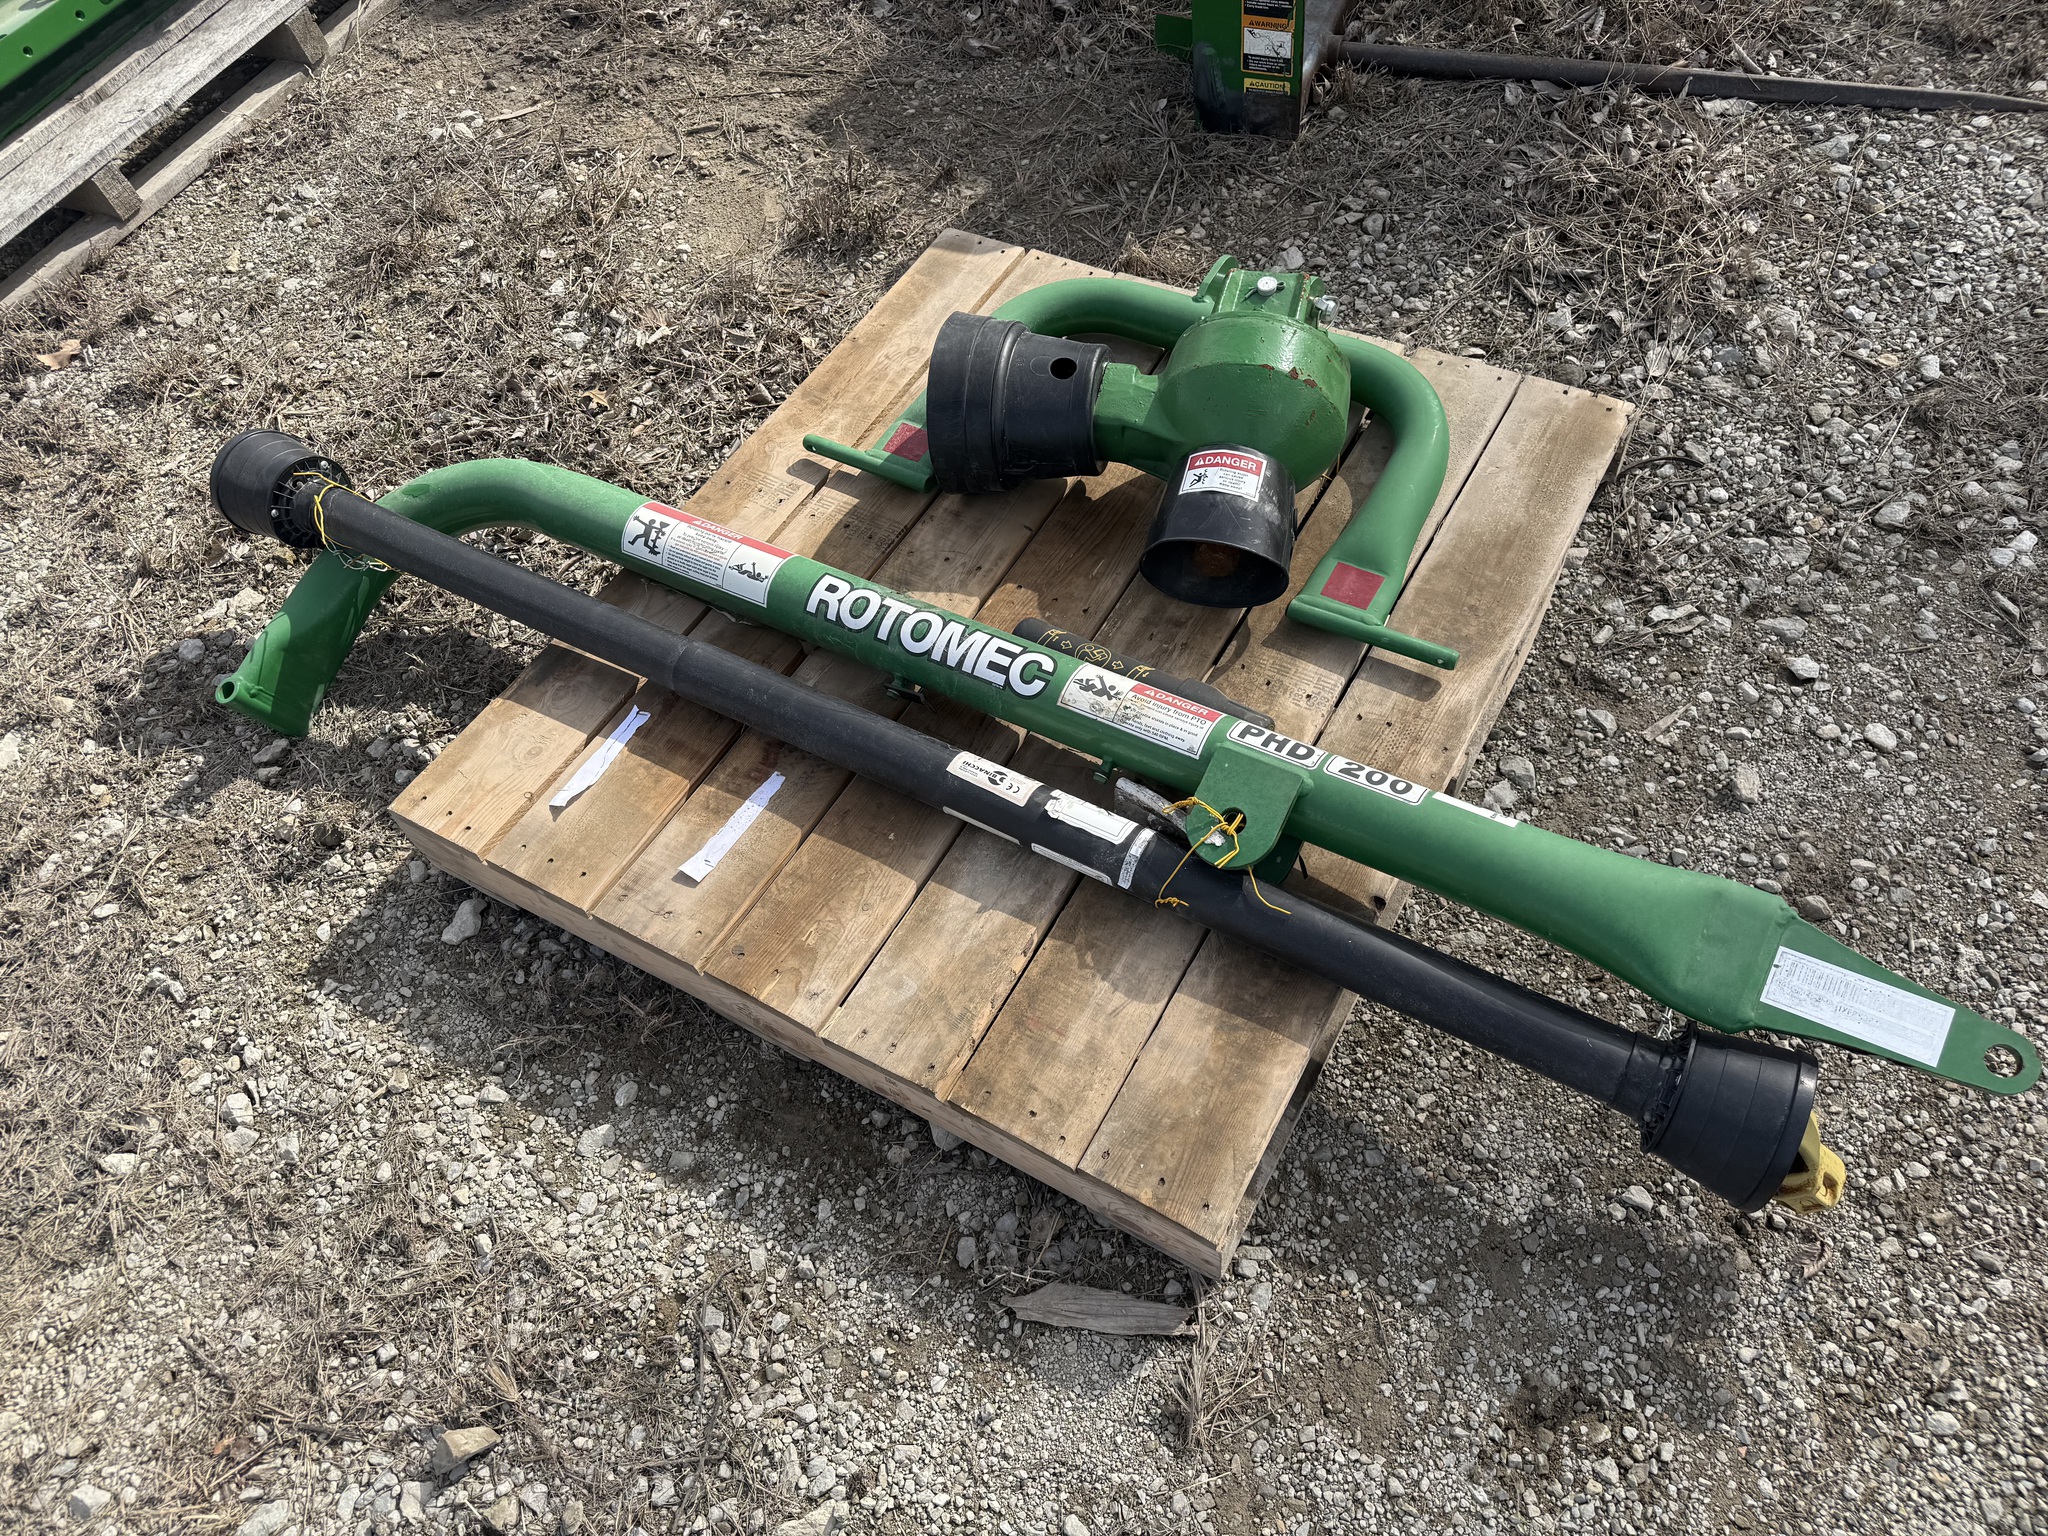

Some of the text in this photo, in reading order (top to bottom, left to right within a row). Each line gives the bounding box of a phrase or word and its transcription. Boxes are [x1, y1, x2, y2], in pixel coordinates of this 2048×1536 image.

[1255, 20, 1287, 30] WARNING
[1255, 81, 1286, 90] CAUTION
[1205, 456, 1257, 471] DANGER
[700, 521, 743, 540] DANGER
[805, 573, 1056, 698] ROTOMEC
[1131, 694, 1151, 705] Avoid
[1152, 700, 1172, 712] injury
[1173, 707, 1189, 720] from
[1191, 715, 1206, 725] PTO
[1155, 693, 1208, 716] DANGER
[1237, 724, 1414, 795] PHD 200
[962, 760, 998, 779] BINACCHI
